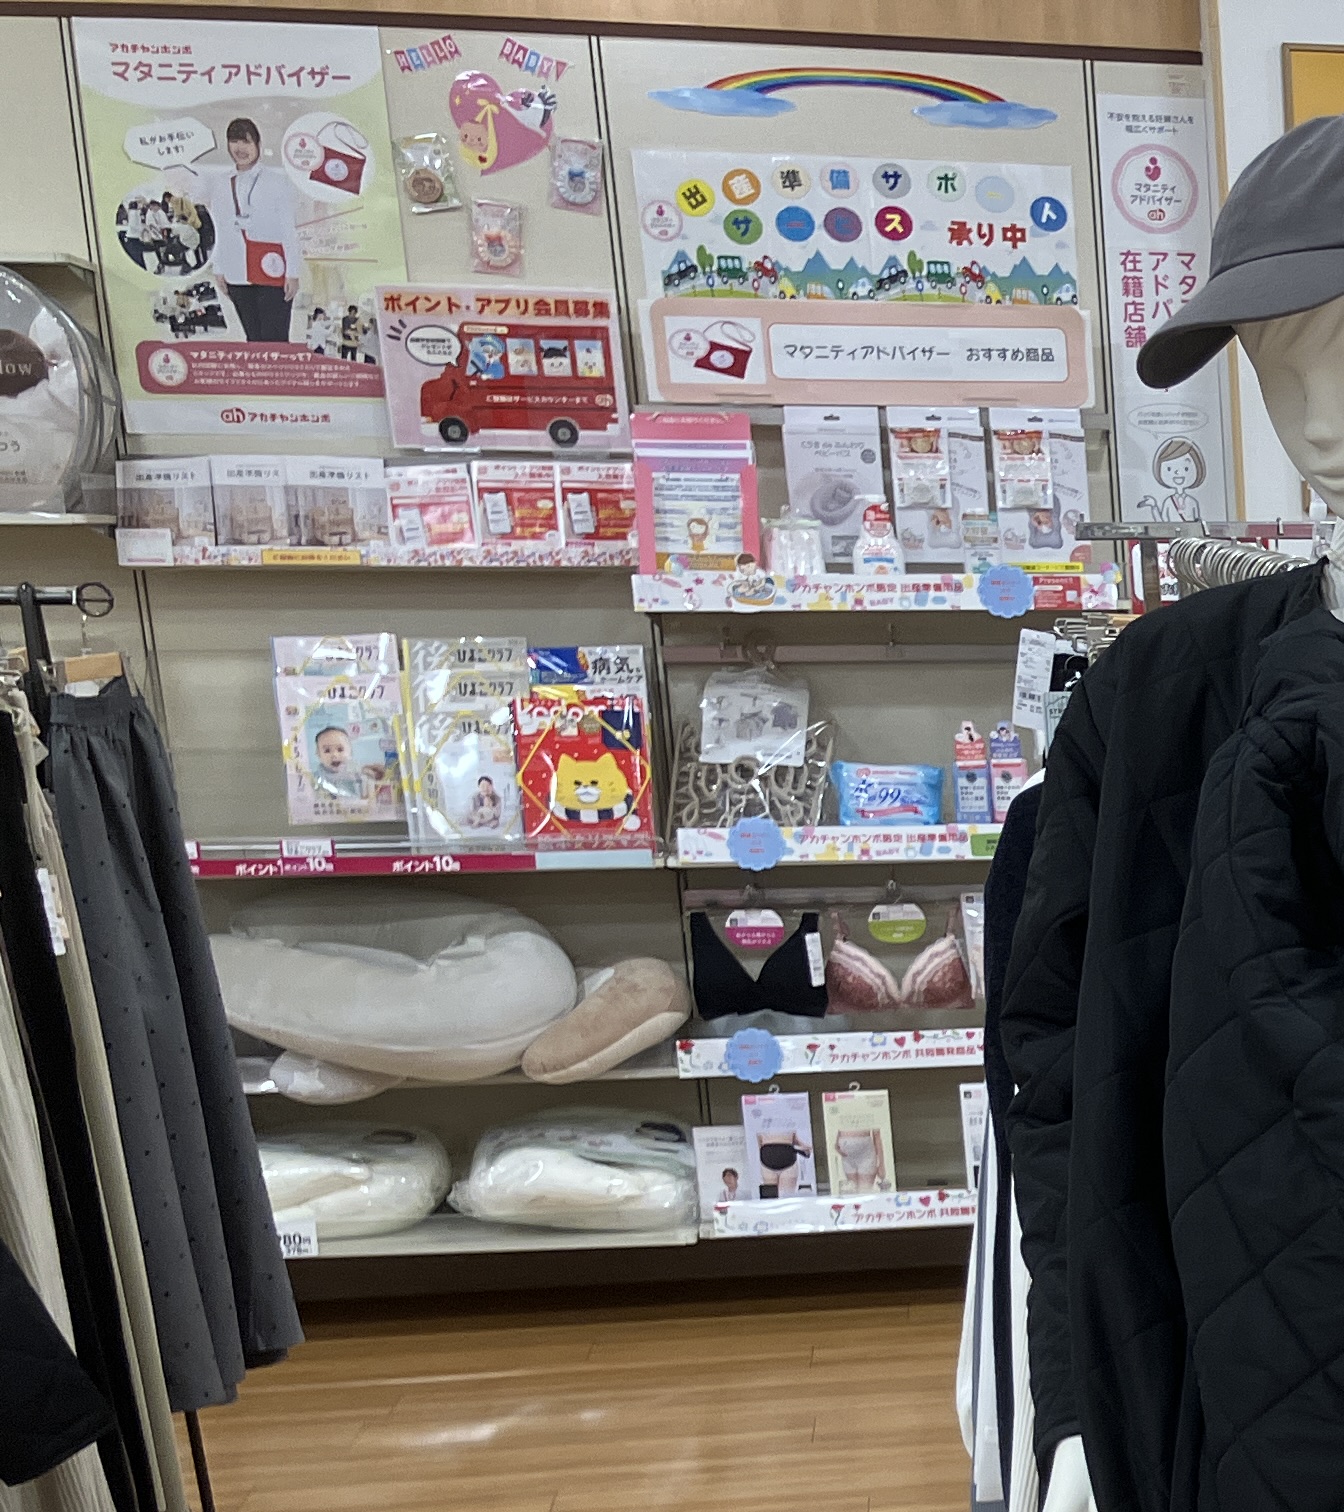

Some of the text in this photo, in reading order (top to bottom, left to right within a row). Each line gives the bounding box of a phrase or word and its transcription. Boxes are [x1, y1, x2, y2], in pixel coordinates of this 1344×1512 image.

[109, 43, 192, 54] アカチャンホンポ
[397, 40, 552, 74] HELLO BABY
[111, 61, 351, 87] マタニティアドバイザー
[139, 131, 195, 146] 私がお手伝い
[1134, 183, 1176, 193] マタニティ
[1130, 195, 1182, 206] アドバイザー
[947, 221, 1028, 248] 承り中
[1177, 252, 1198, 306] マタ
[1120, 250, 1147, 348] 在籍店舗
[783, 344, 1055, 362] マタニティアドバイザー おすすめ商品
[248, 412, 331, 424] アカチャンホンポ
[226, 468, 280, 480] 出産準備リス
